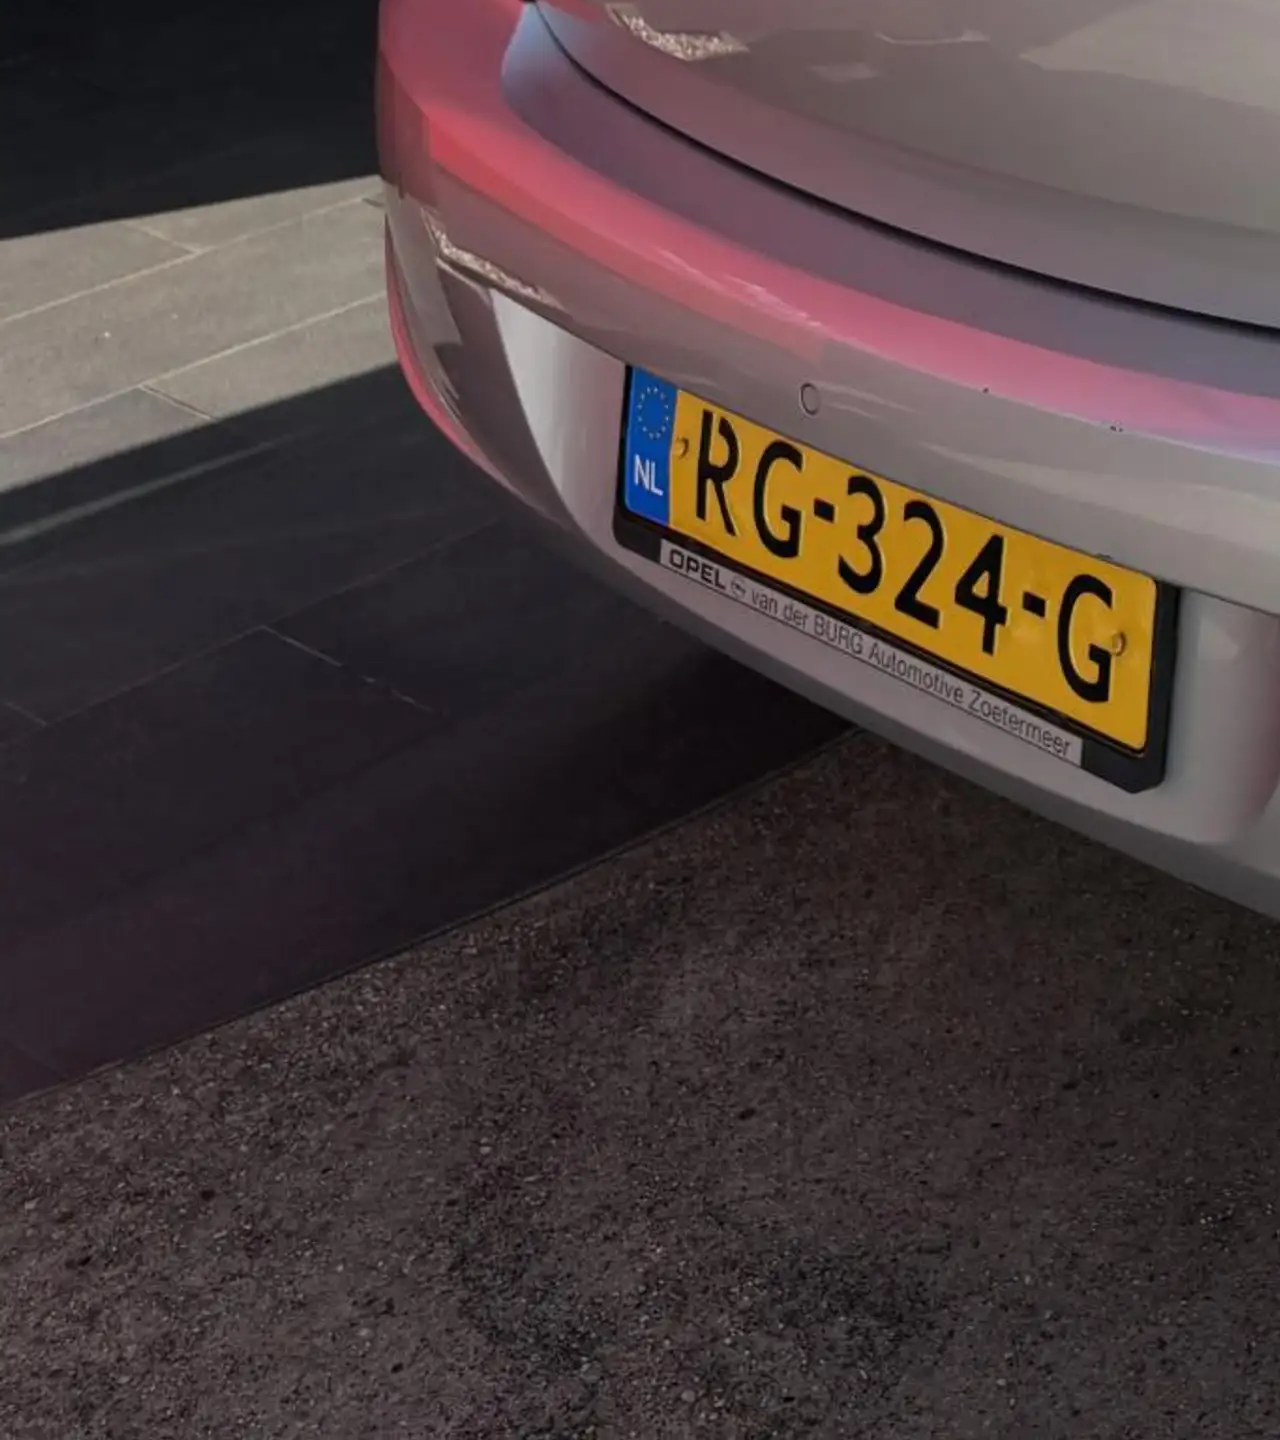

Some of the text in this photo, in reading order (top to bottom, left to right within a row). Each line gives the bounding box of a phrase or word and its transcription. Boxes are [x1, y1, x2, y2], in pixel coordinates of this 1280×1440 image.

[634, 454, 664, 498] NL
[695, 409, 1115, 705] RG-324-G
[669, 548, 1072, 757] OPEL van der BURG Automotive Zoetermeer
